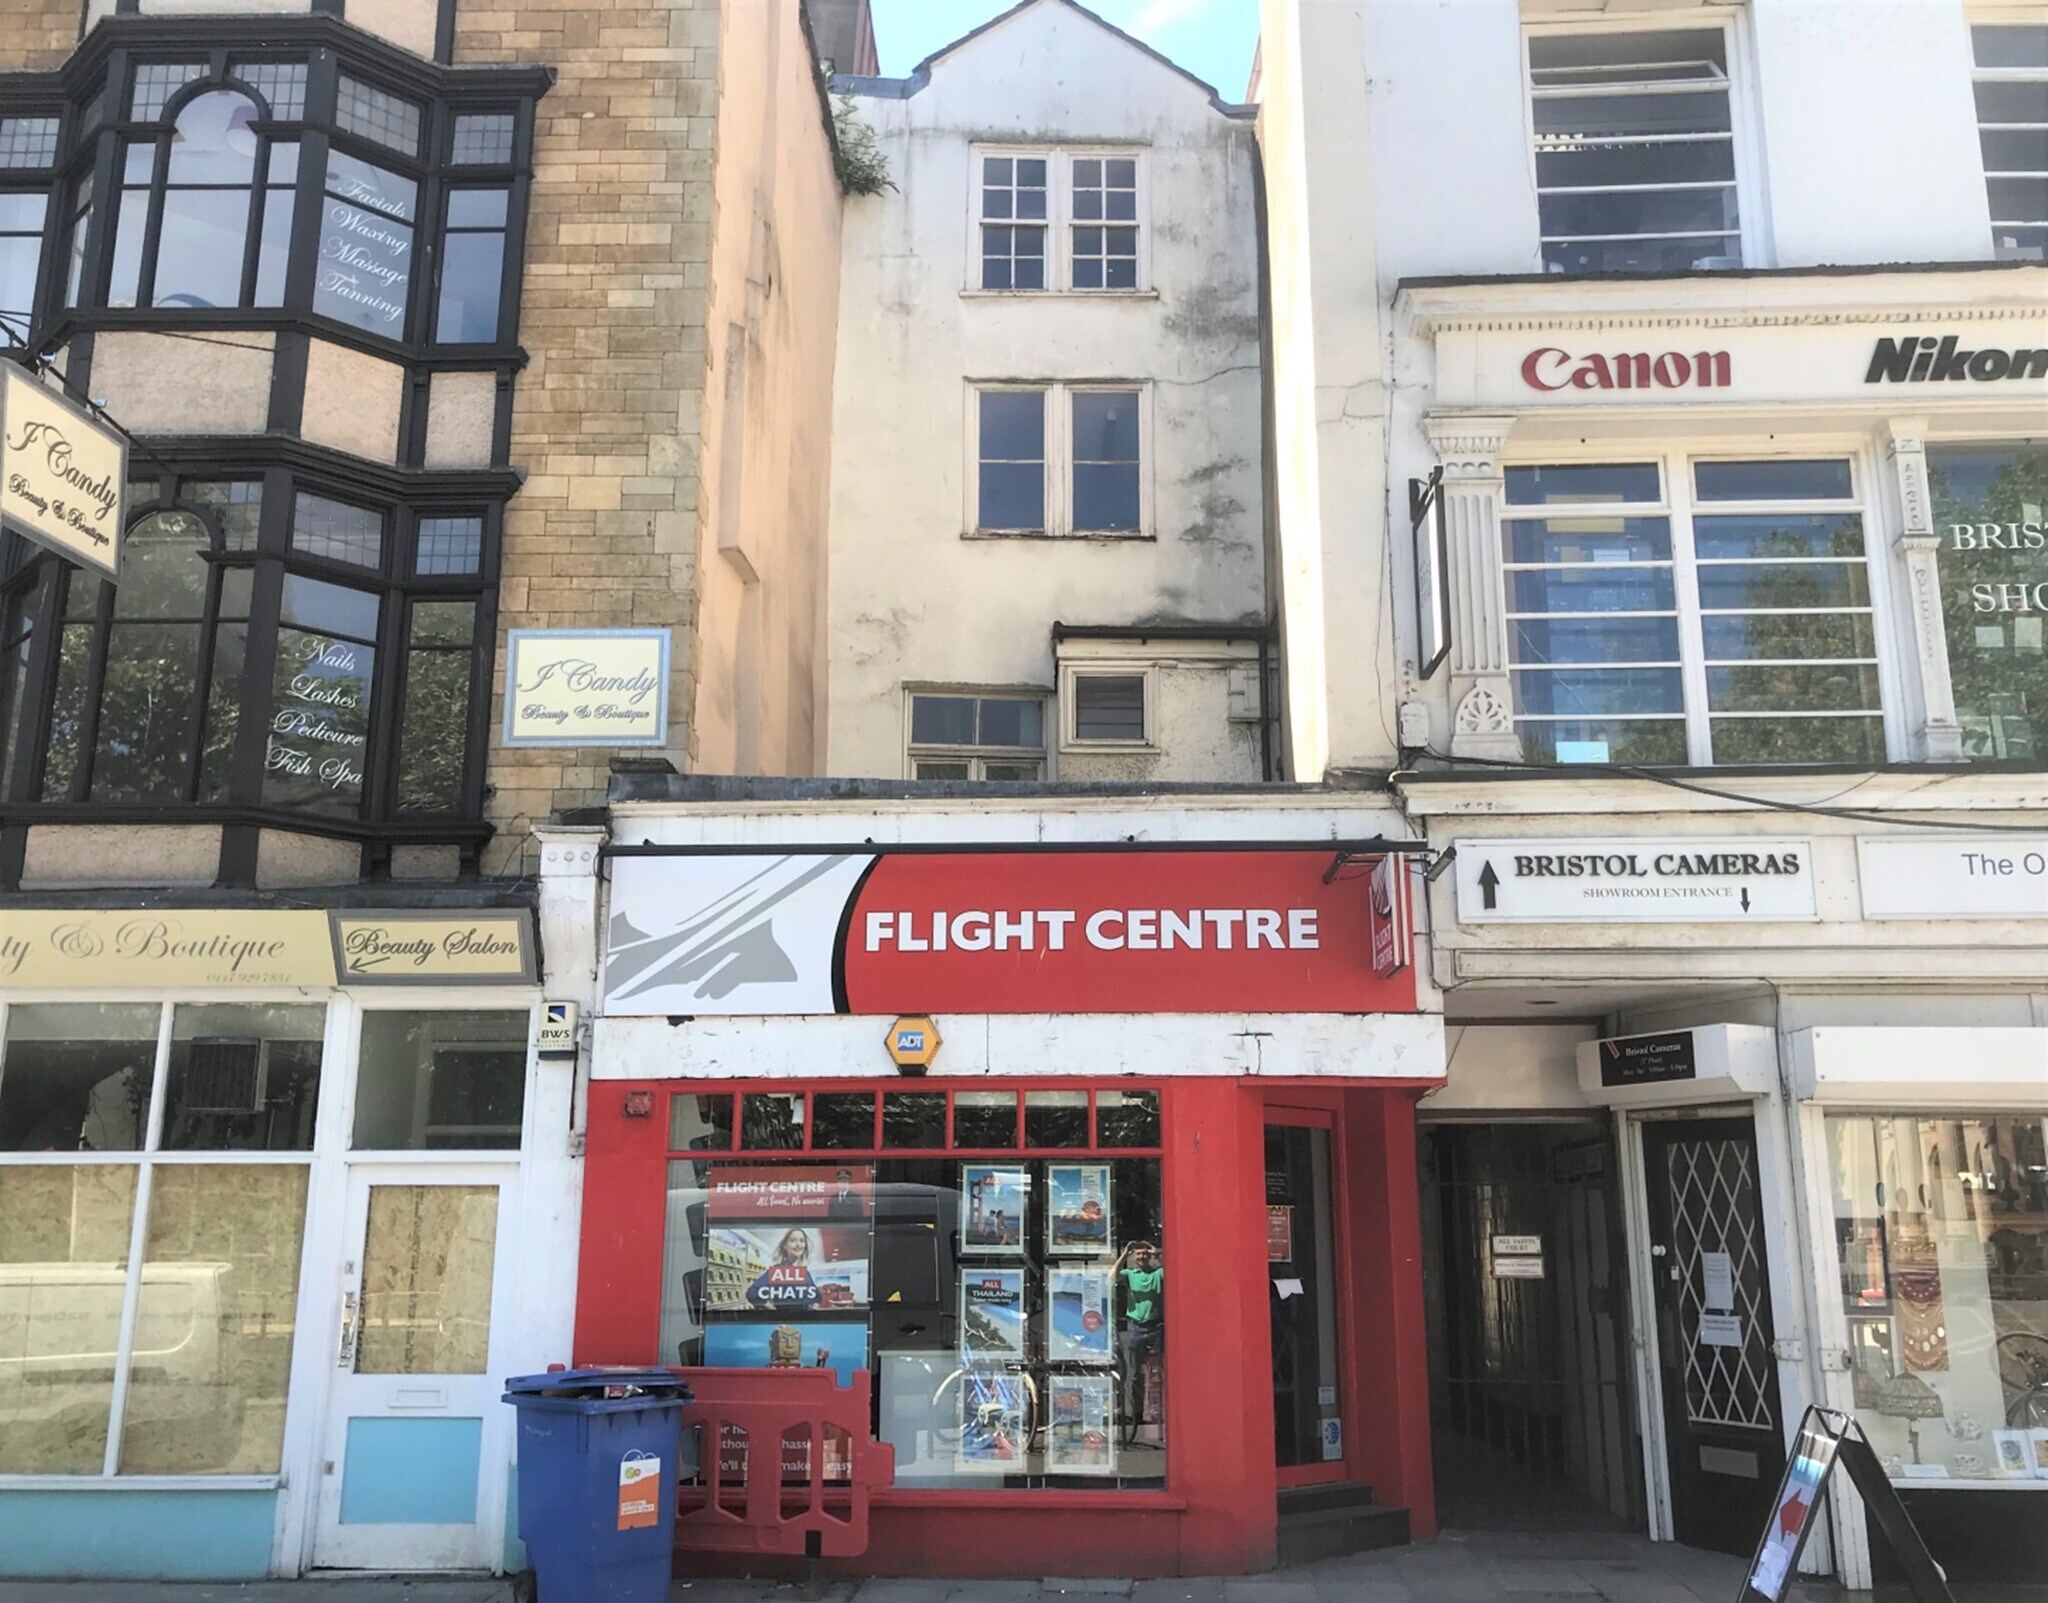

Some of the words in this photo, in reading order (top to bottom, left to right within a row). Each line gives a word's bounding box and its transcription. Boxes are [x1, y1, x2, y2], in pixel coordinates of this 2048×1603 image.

[337, 178, 406, 217] Facials
[330, 205, 409, 256] Waxing
[322, 236, 408, 287] Massage
[319, 269, 404, 322] Tanning
[1520, 346, 1732, 391] Canon
[1864, 335, 2048, 384] Nikon
[43, 425, 117, 521] Candy
[8, 473, 48, 517] Beauty
[67, 507, 110, 547] Boutique
[1949, 522, 2048, 550] BRIS
[295, 637, 356, 671] Nails
[286, 673, 357, 709] Lashes
[560, 658, 658, 705] Candy
[273, 709, 364, 746] Pedicure
[521, 703, 569, 725] Beauty
[593, 703, 650, 724] Boutique
[264, 744, 313, 775] Fish
[319, 757, 364, 789] Spa
[1513, 855, 1647, 877] BRISTOL
[1653, 853, 1800, 876] CAMERAS
[1961, 853, 2014, 875] The
[1582, 887, 1660, 898] SHOWROOM
[1662, 886, 1733, 898] ENTRANCE
[51, 919, 104, 958] &
[115, 918, 285, 972] Boutique
[345, 927, 436, 966] Beauty
[442, 928, 518, 960] Salon
[863, 910, 1076, 952] FLIGHT
[1085, 908, 1320, 950] CENTRE
[541, 1029, 570, 1039] BWS
[898, 1033, 924, 1049] ADT
[1625, 1046, 1648, 1056] Bristol
[1649, 1043, 1682, 1054] Cameras
[716, 1182, 768, 1194] FLIGHT
[769, 1181, 825, 1193] CENTRE
[757, 1286, 817, 1299] CHATS
[771, 1269, 804, 1281] ALL
[983, 1281, 999, 1289] ALL
[972, 1290, 1014, 1298] THAILAND
[720, 1460, 738, 1471] e'll
